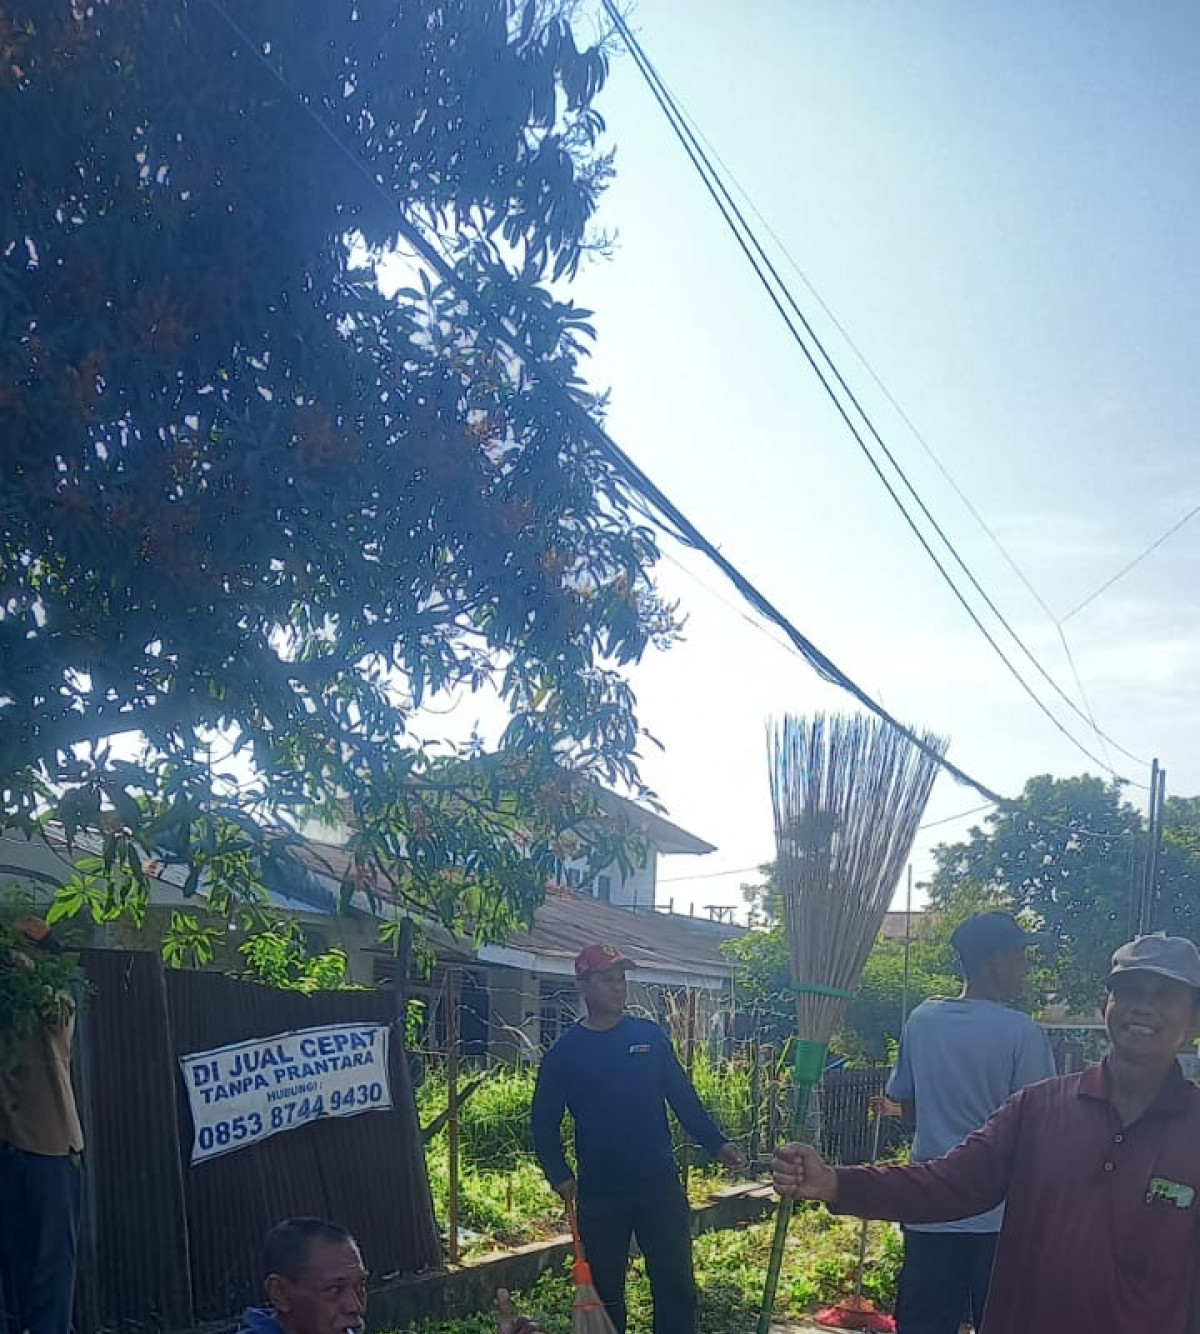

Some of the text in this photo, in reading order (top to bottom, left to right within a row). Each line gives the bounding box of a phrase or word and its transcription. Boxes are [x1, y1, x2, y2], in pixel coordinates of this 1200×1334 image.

[192, 1029, 378, 1087] DI JUAL CEPAT
[200, 1050, 374, 1104] TANPA PRANTARA
[198, 1082, 382, 1150] 0853 8744 9430
